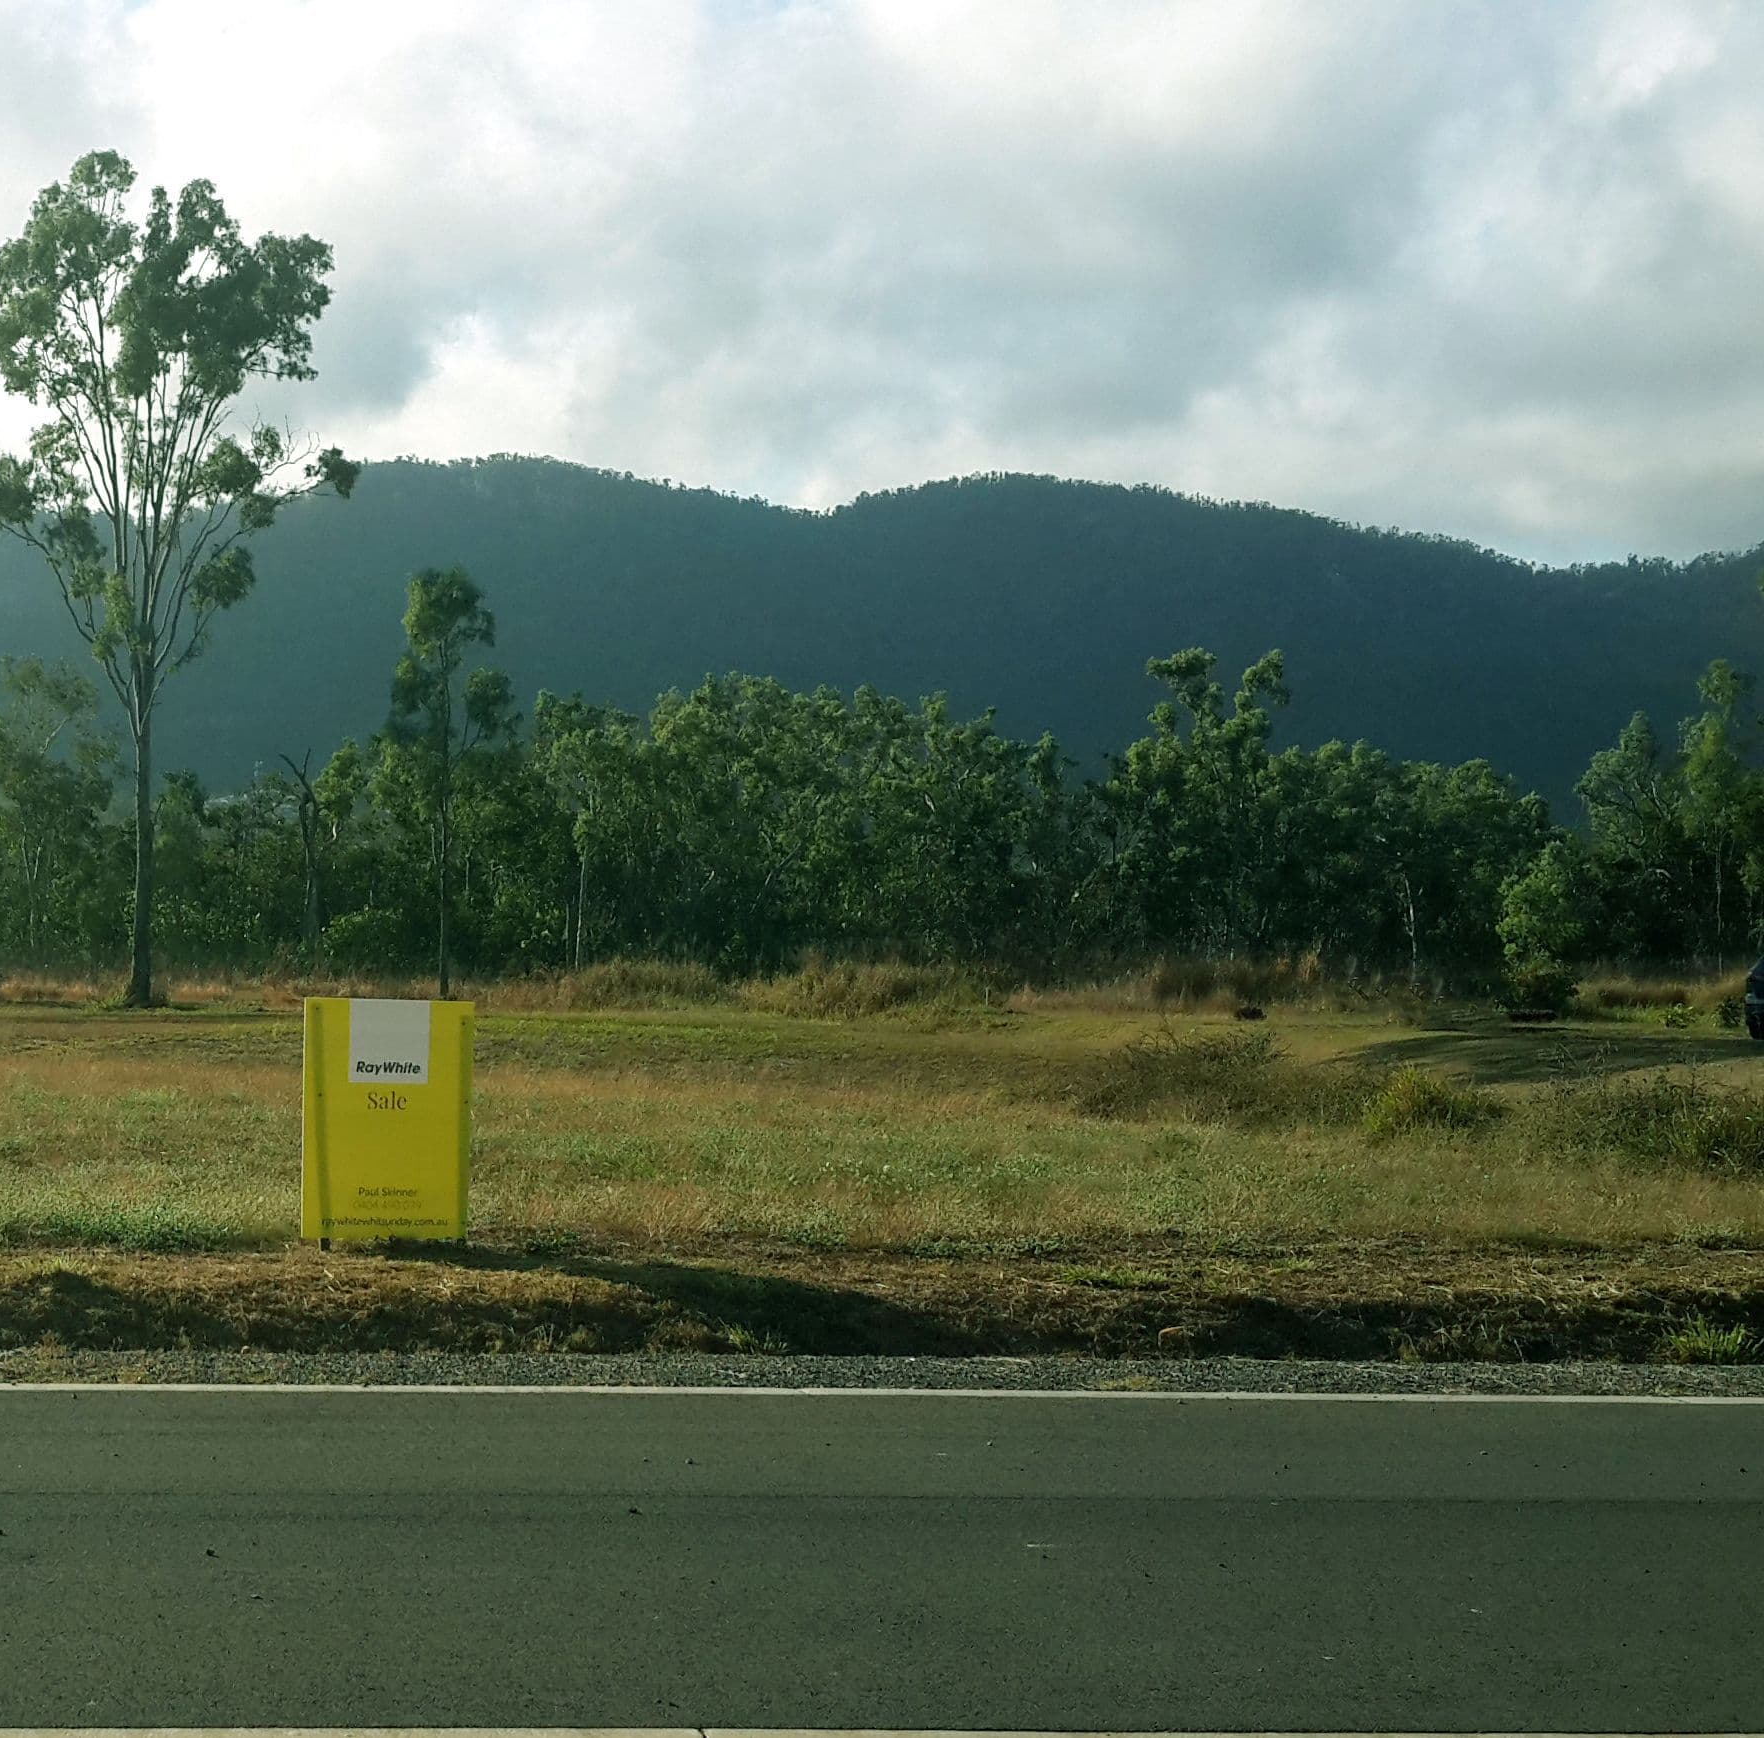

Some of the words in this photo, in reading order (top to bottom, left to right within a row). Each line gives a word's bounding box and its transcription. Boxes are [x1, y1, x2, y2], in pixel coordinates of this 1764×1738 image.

[367, 1091, 407, 1110] Sale
[358, 1186, 379, 1197] Paul
[381, 1186, 418, 1197] Skinner
